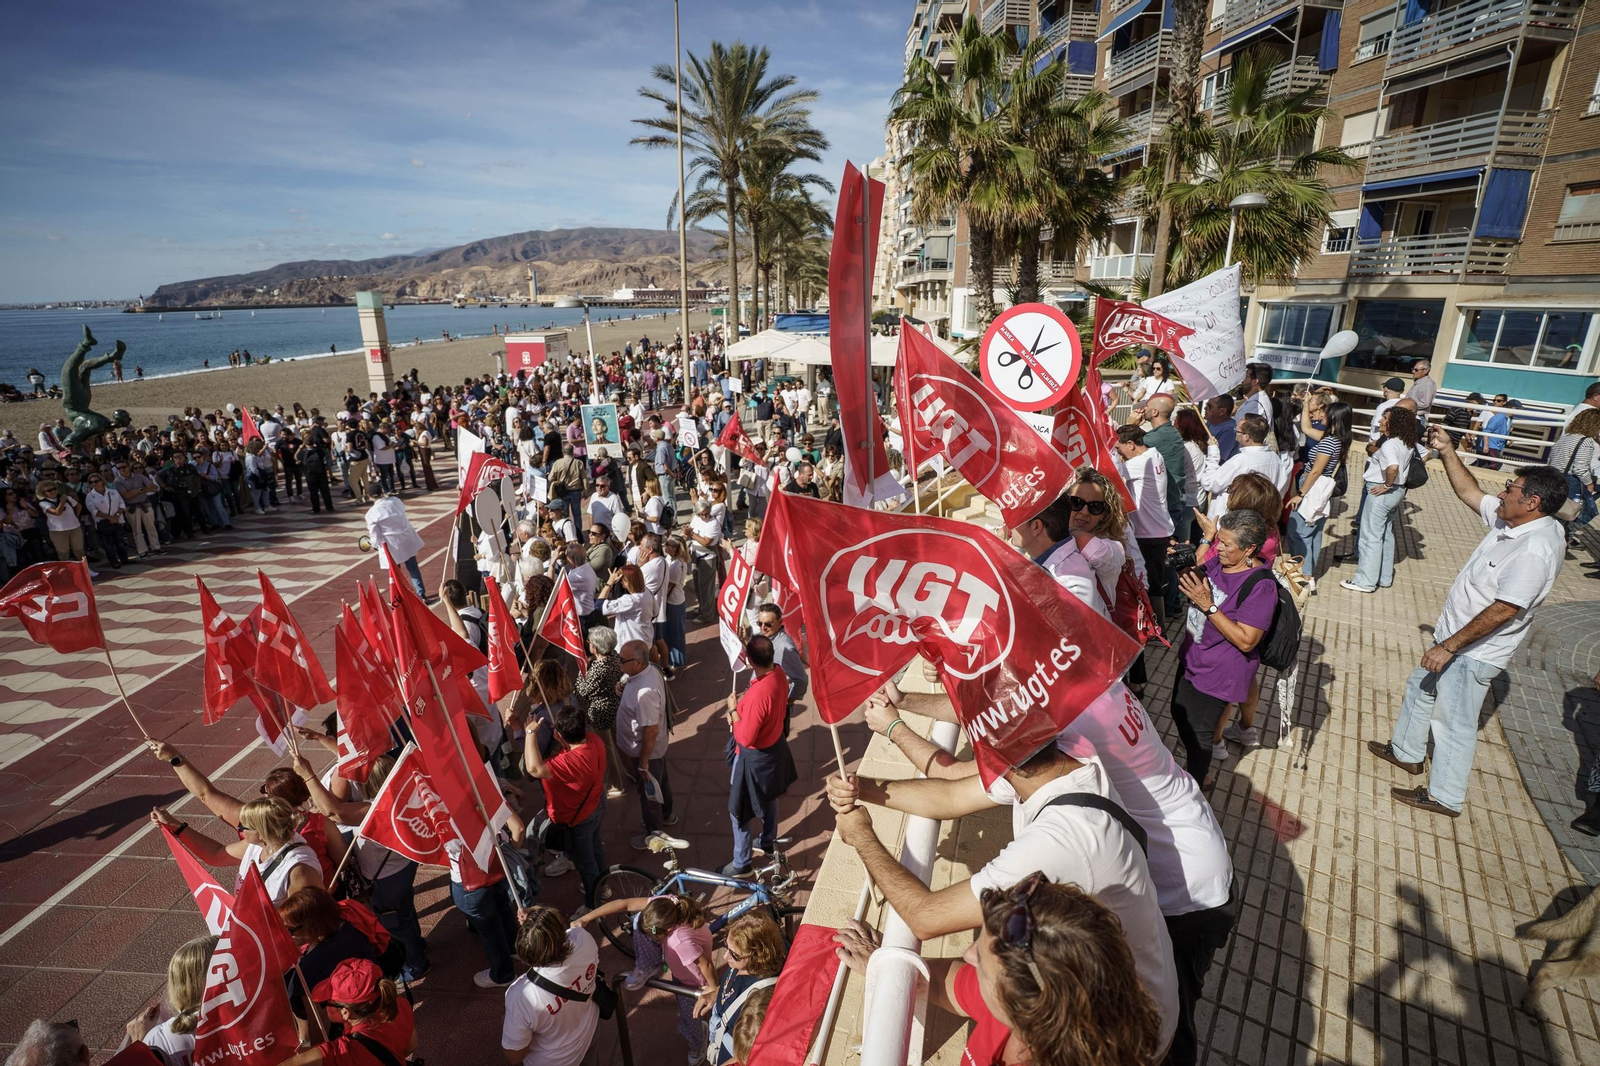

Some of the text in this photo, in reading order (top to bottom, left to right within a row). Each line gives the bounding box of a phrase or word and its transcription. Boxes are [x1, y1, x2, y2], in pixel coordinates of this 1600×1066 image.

[1000, 327, 1015, 342] MAREA
[1020, 350, 1037, 368] BLANCA
[1284, 356, 1318, 368] RESTAURANTE
[911, 383, 992, 471] UGT
[848, 555, 1000, 646] UGT
